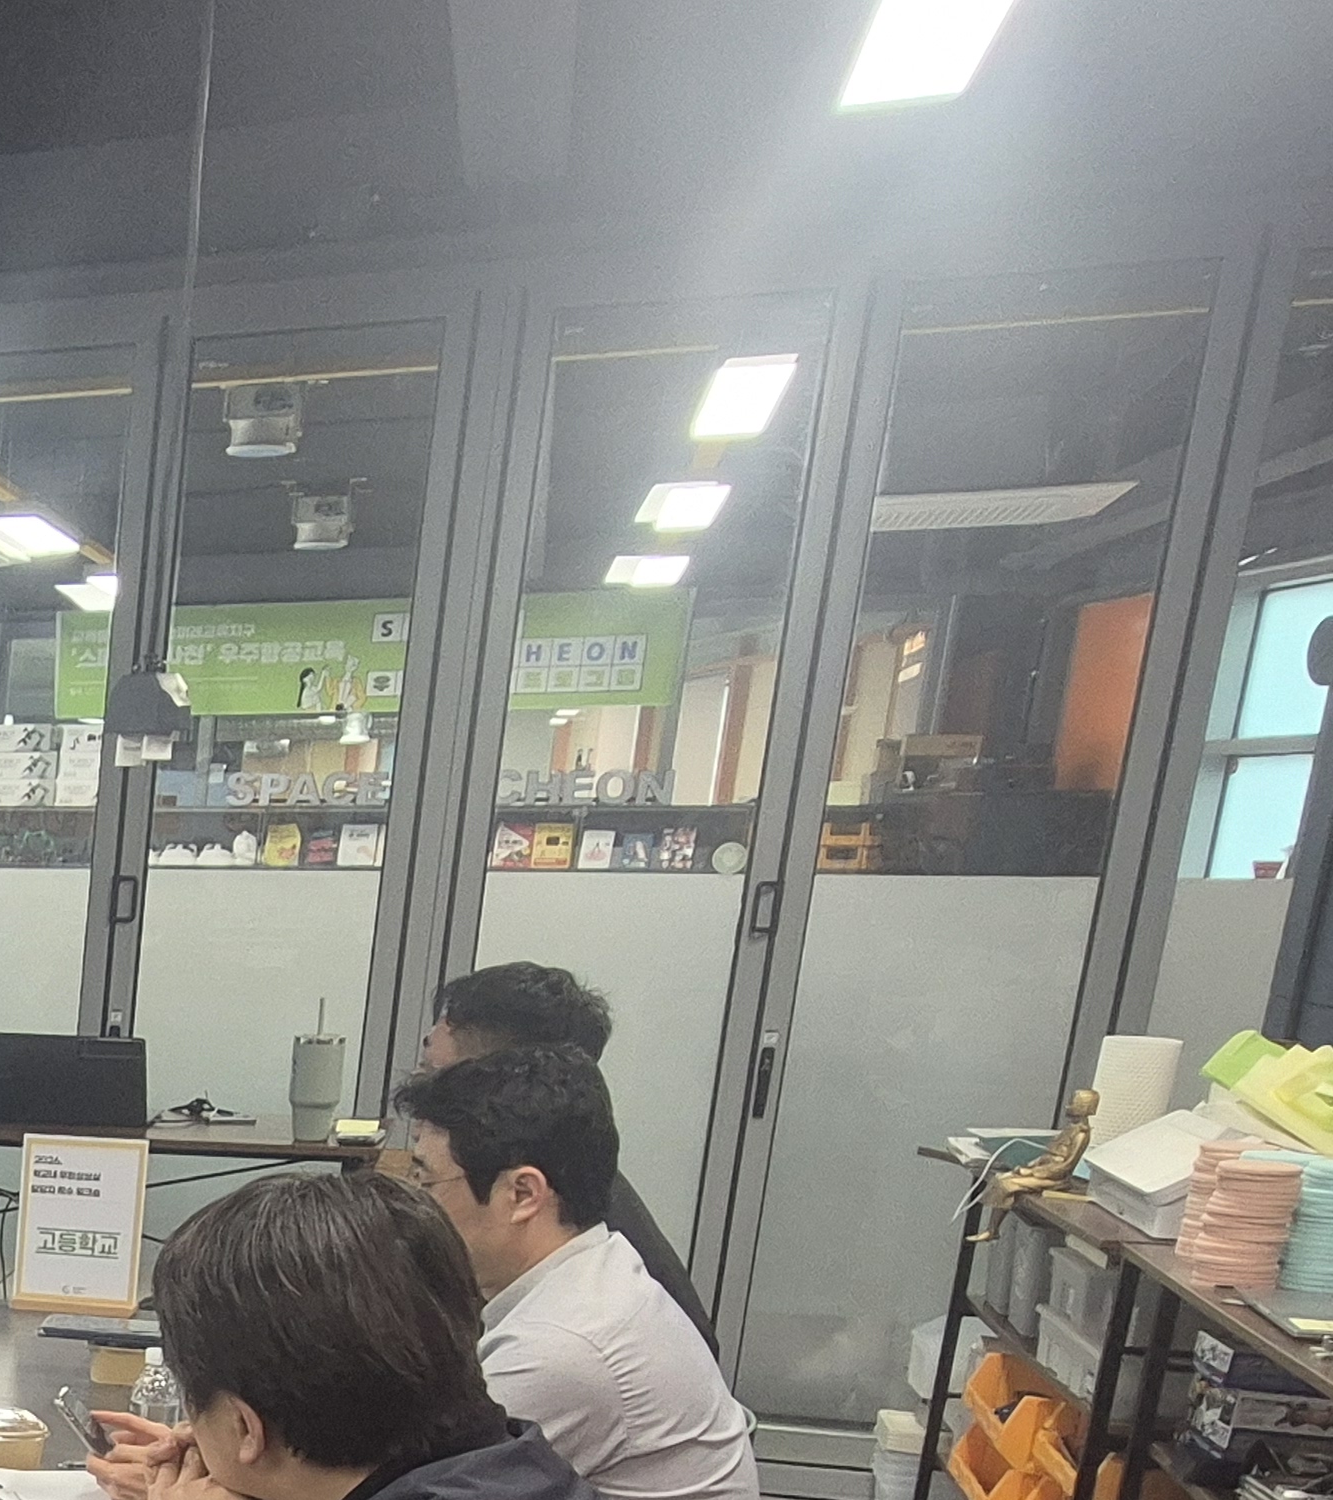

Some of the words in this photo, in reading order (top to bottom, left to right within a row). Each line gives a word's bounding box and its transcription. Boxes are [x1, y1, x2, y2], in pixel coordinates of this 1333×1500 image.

[380, 619, 394, 638] S
[226, 770, 389, 807] SPACE
[37, 1231, 118, 1255] 고등학교
